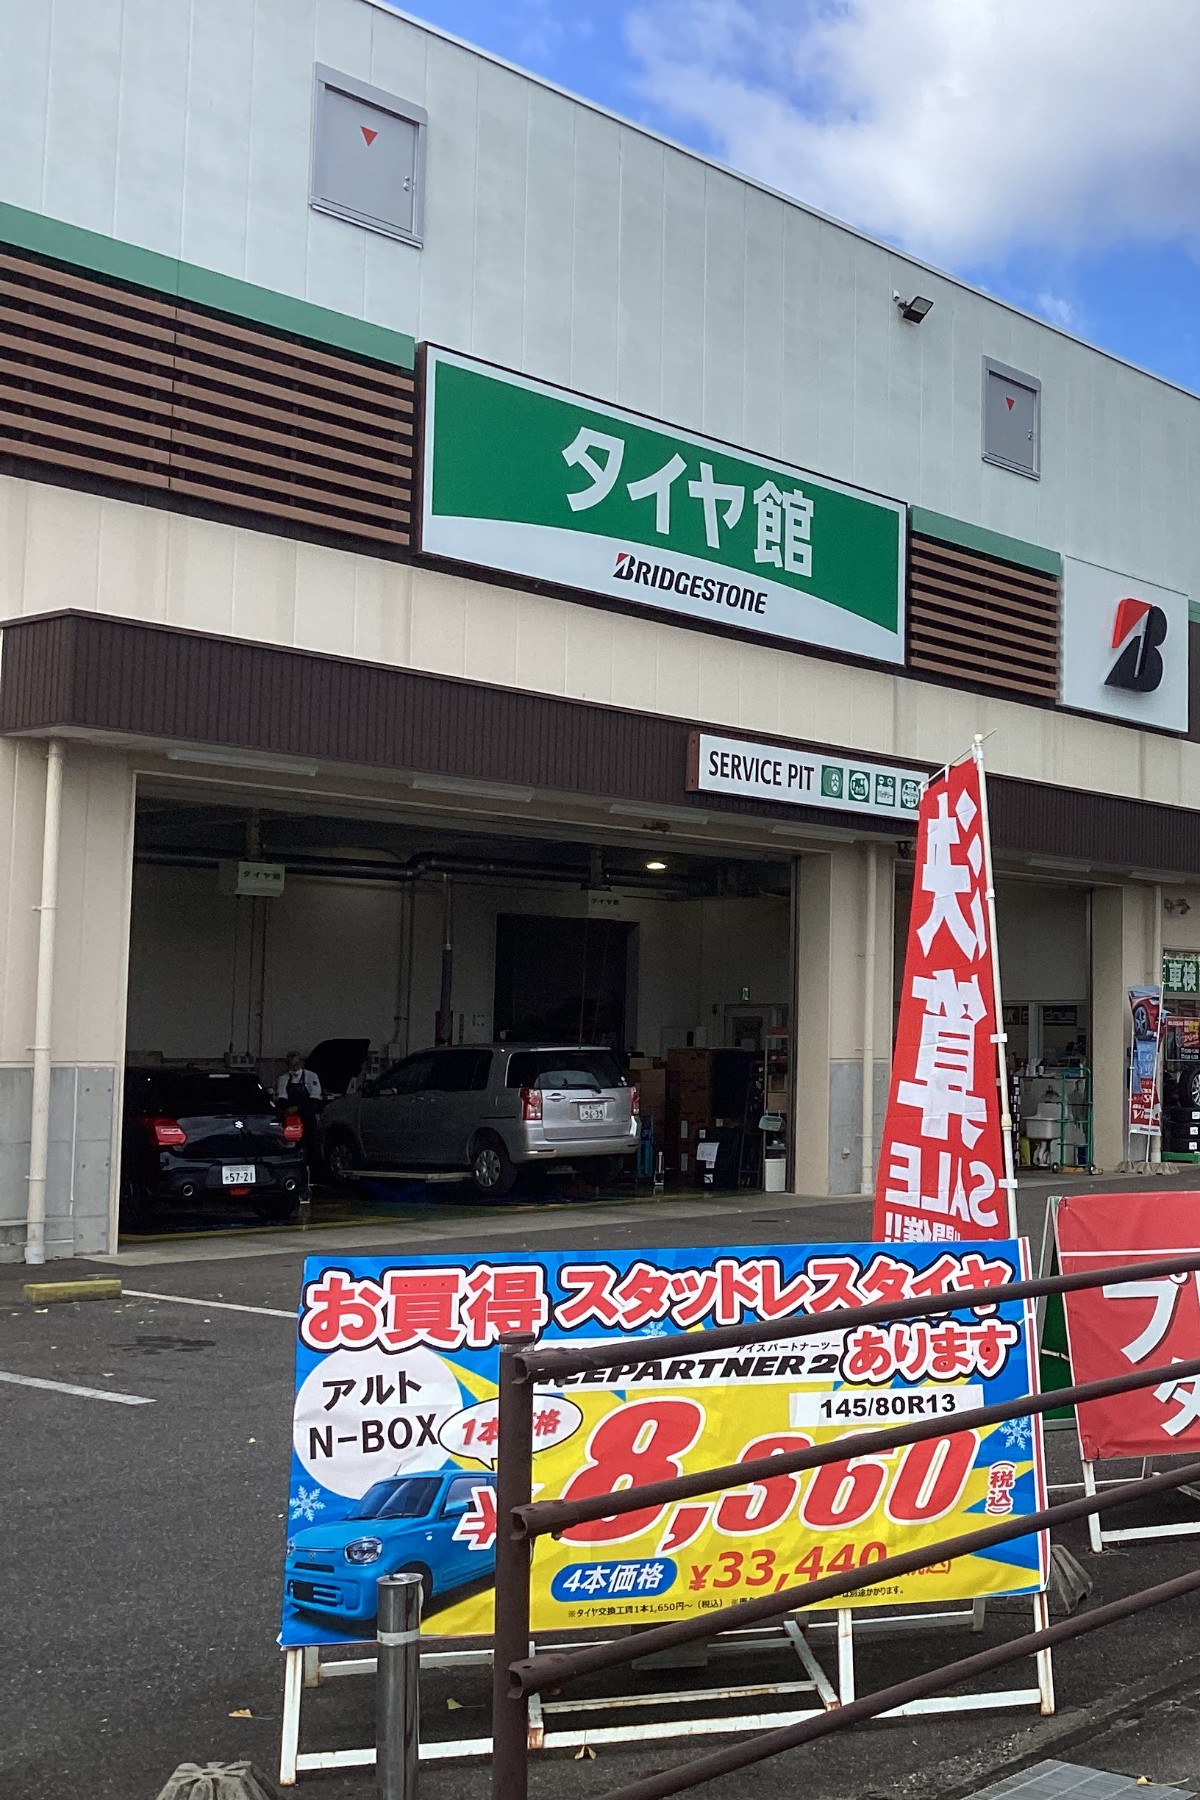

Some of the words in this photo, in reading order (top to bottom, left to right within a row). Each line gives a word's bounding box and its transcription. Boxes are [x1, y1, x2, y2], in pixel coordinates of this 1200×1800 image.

[561, 426, 814, 578] タイヤ館
[612, 552, 768, 616] BRIDGESTONE
[708, 750, 782, 787] SERVICE
[787, 763, 814, 791] PIT
[1168, 961, 1197, 992] 車検
[306, 1268, 546, 1347] お買得
[807, 1353, 839, 1375] 2
[847, 1323, 1013, 1380] あります
[322, 1370, 423, 1412] アルト
[820, 1394, 956, 1419] 145/80R13
[308, 1413, 438, 1460] N-BOX
[461, 1408, 561, 1447] 1本格
[985, 1462, 1015, 1515] (税込)
[562, 1563, 664, 1595] 4本価格
